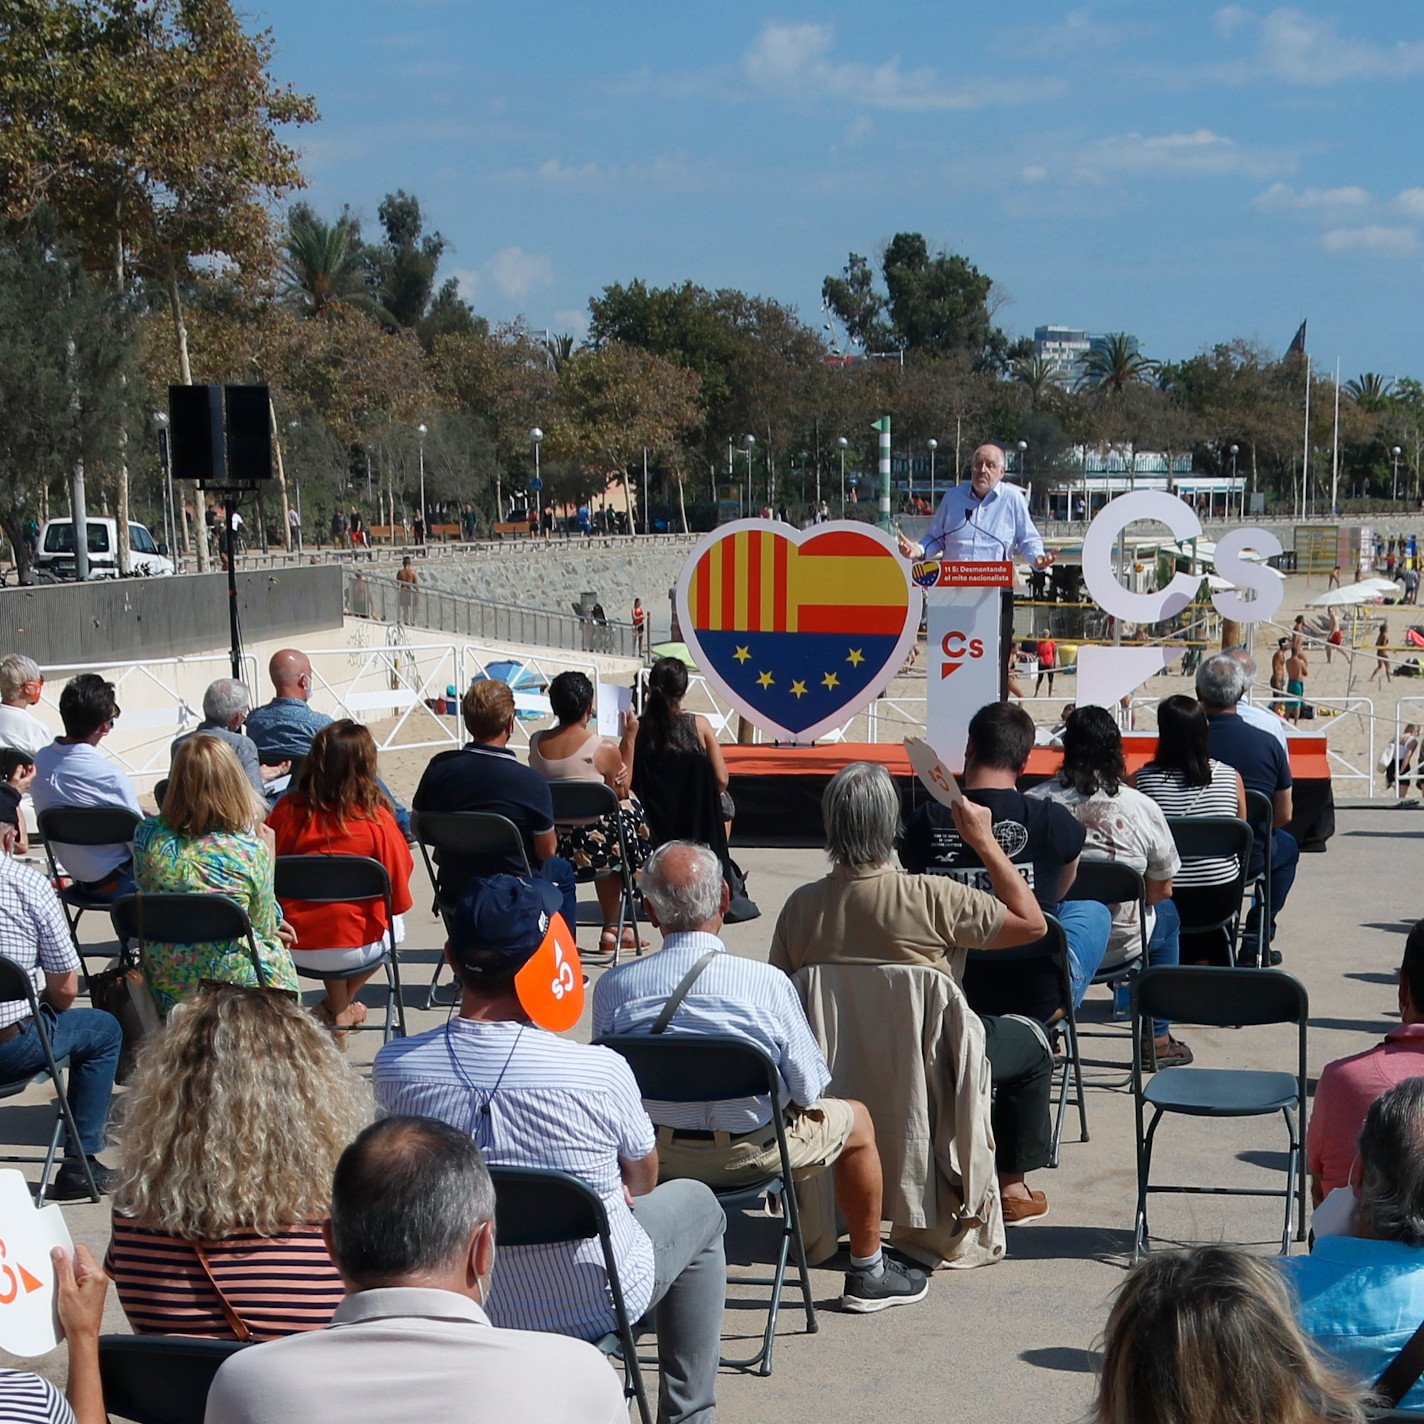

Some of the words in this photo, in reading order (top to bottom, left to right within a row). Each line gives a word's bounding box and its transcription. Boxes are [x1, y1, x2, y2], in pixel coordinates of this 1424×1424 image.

[1082, 490, 1284, 623] Cs
[942, 631, 984, 658] Cs
[552, 962, 574, 1000] Cs
